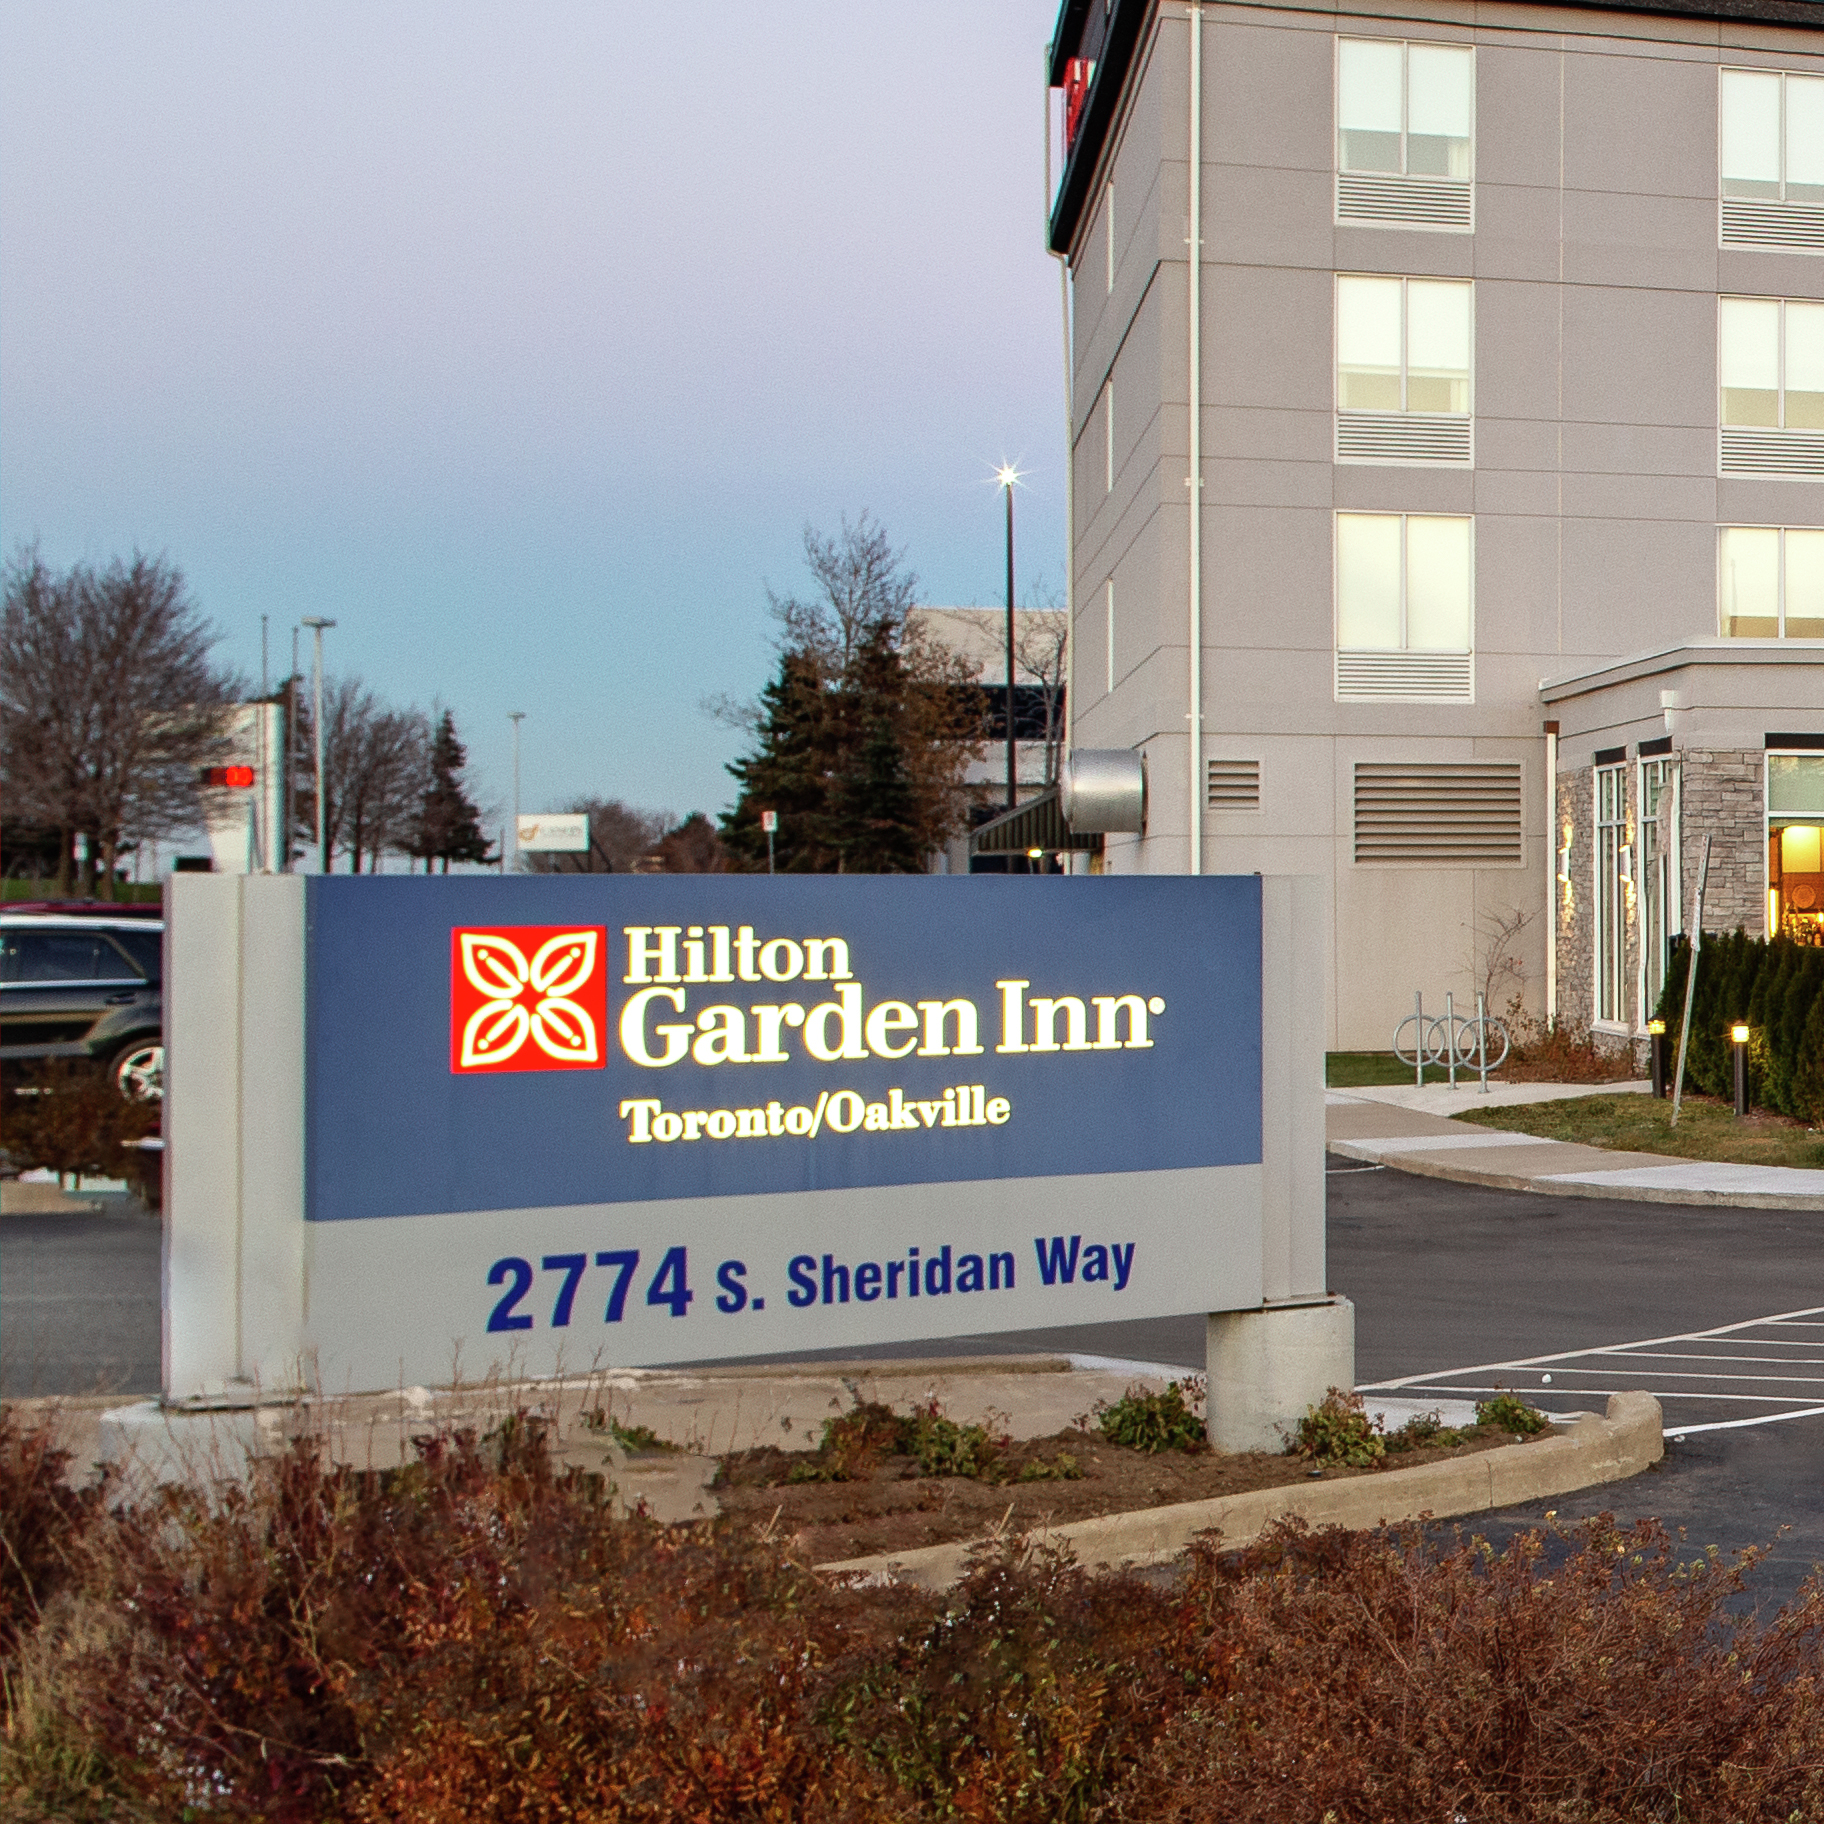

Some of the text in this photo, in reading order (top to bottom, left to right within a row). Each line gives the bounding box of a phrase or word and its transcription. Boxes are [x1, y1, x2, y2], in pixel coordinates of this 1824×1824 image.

[622, 925, 854, 984] Hilton
[618, 979, 1156, 1069] Garden Inn
[618, 1083, 1012, 1144] Toronto/Oakville
[486, 1234, 1137, 1334] 2774 S. Sheridan Way
